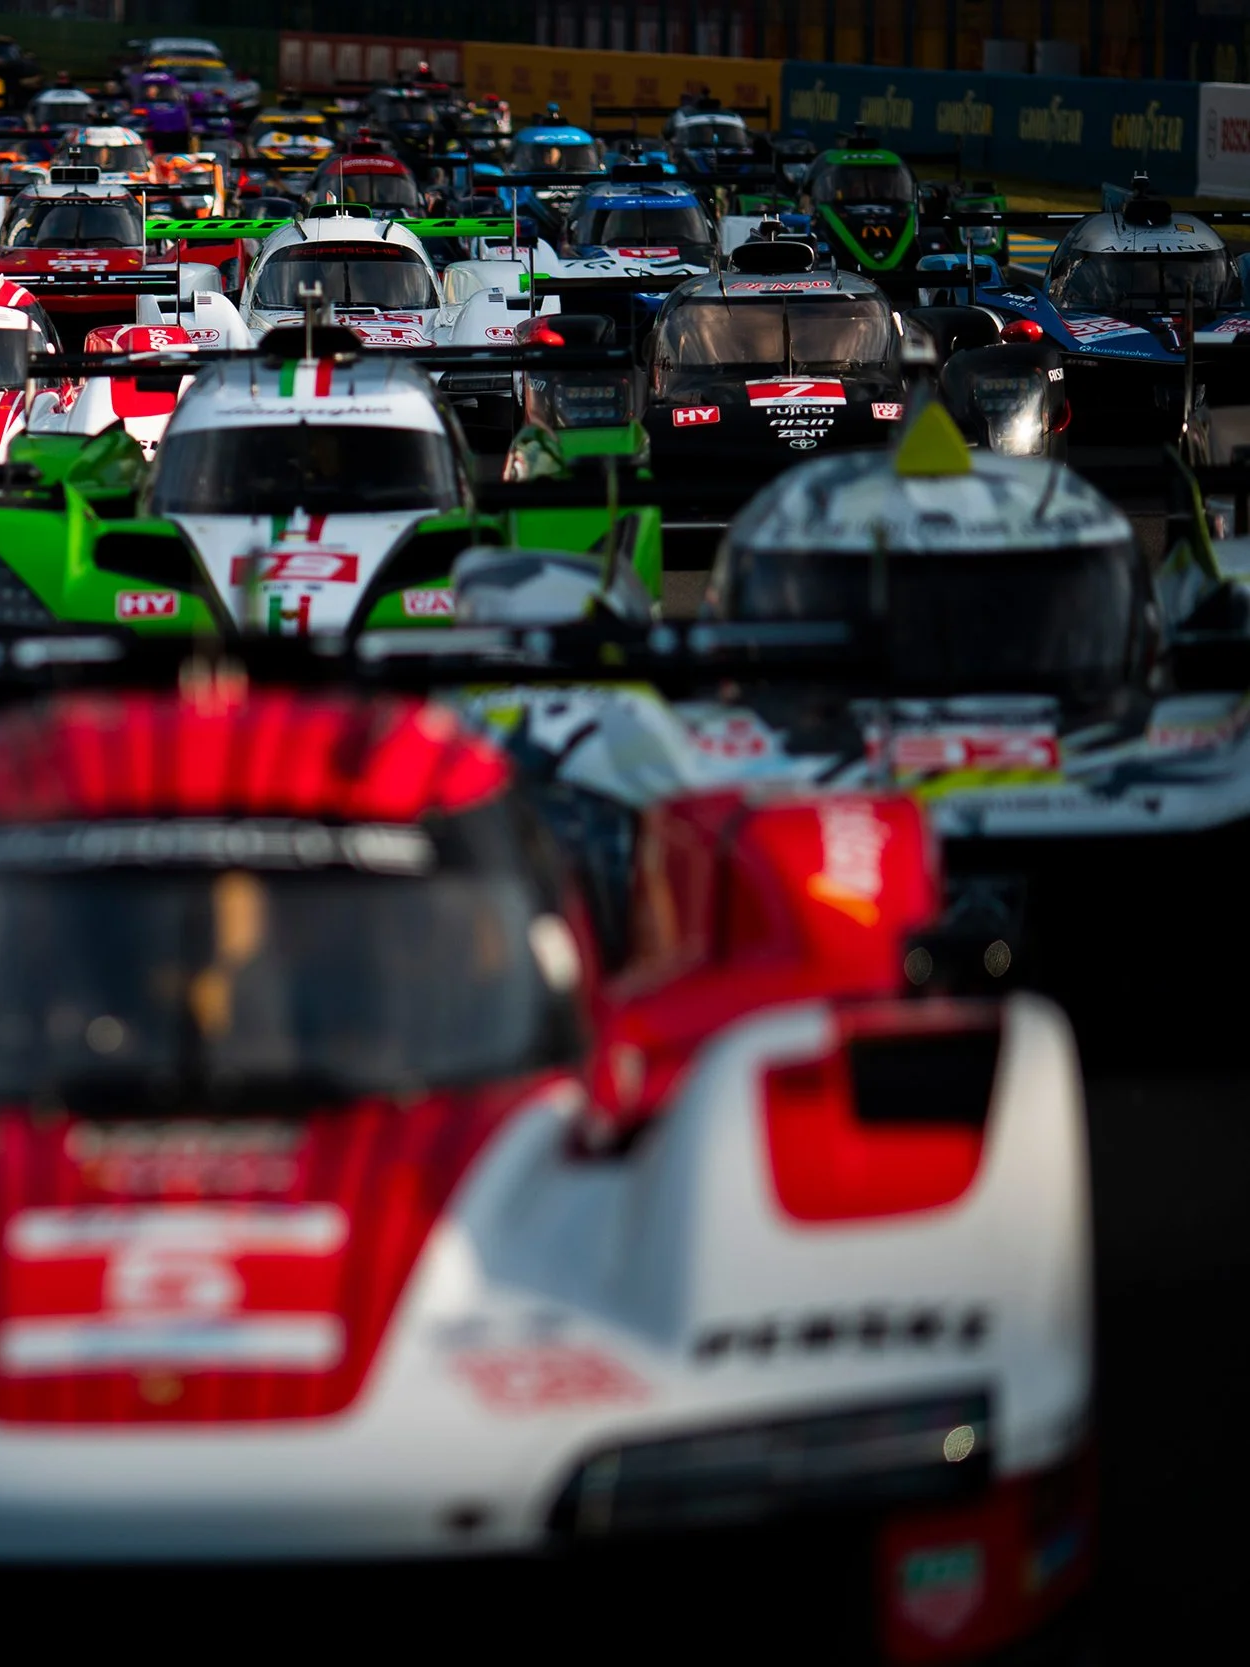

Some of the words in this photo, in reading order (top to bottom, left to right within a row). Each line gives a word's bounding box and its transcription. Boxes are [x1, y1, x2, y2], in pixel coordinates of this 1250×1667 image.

[1100, 243, 1212, 252] ALPINE
[729, 280, 832, 290] DENSO
[1092, 346, 1153, 358] businessolver
[778, 383, 815, 397] 7
[676, 408, 716, 424] HY
[766, 406, 835, 416] FUJITSU
[777, 429, 829, 438] ZENT
[120, 594, 170, 613] HY
